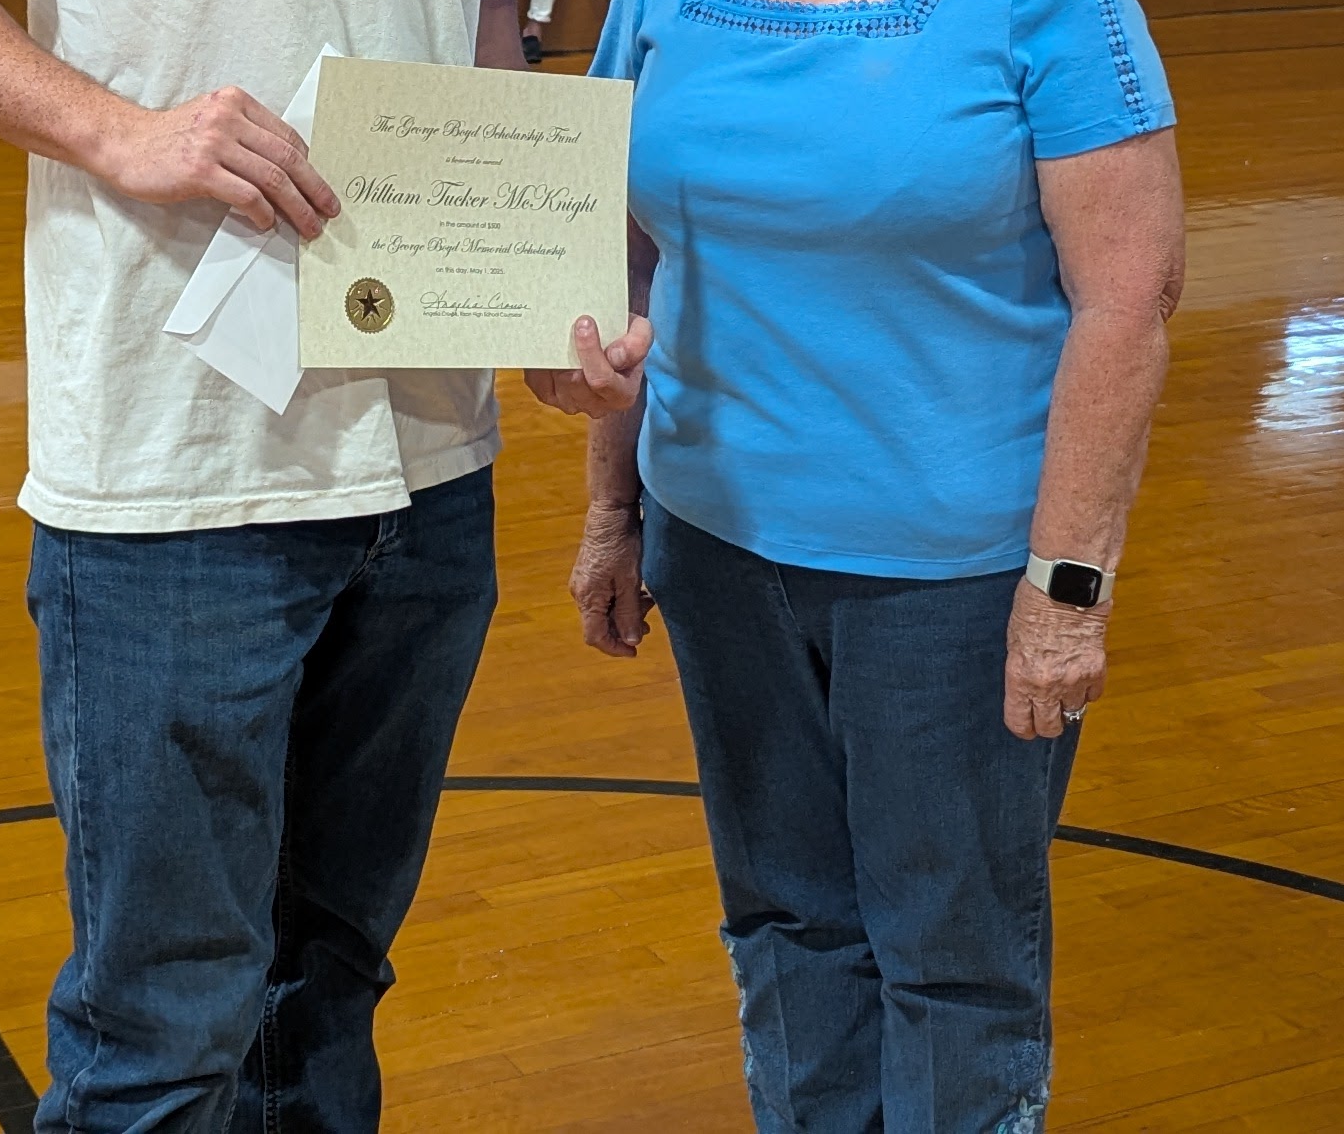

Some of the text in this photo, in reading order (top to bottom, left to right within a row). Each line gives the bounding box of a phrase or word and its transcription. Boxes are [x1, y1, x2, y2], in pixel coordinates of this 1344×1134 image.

[370, 115, 582, 147] The George Boyd Scholarship Fund
[346, 174, 598, 223] William Tucker McKnight
[372, 235, 567, 261] the George Boyd Memorial Scholarship
